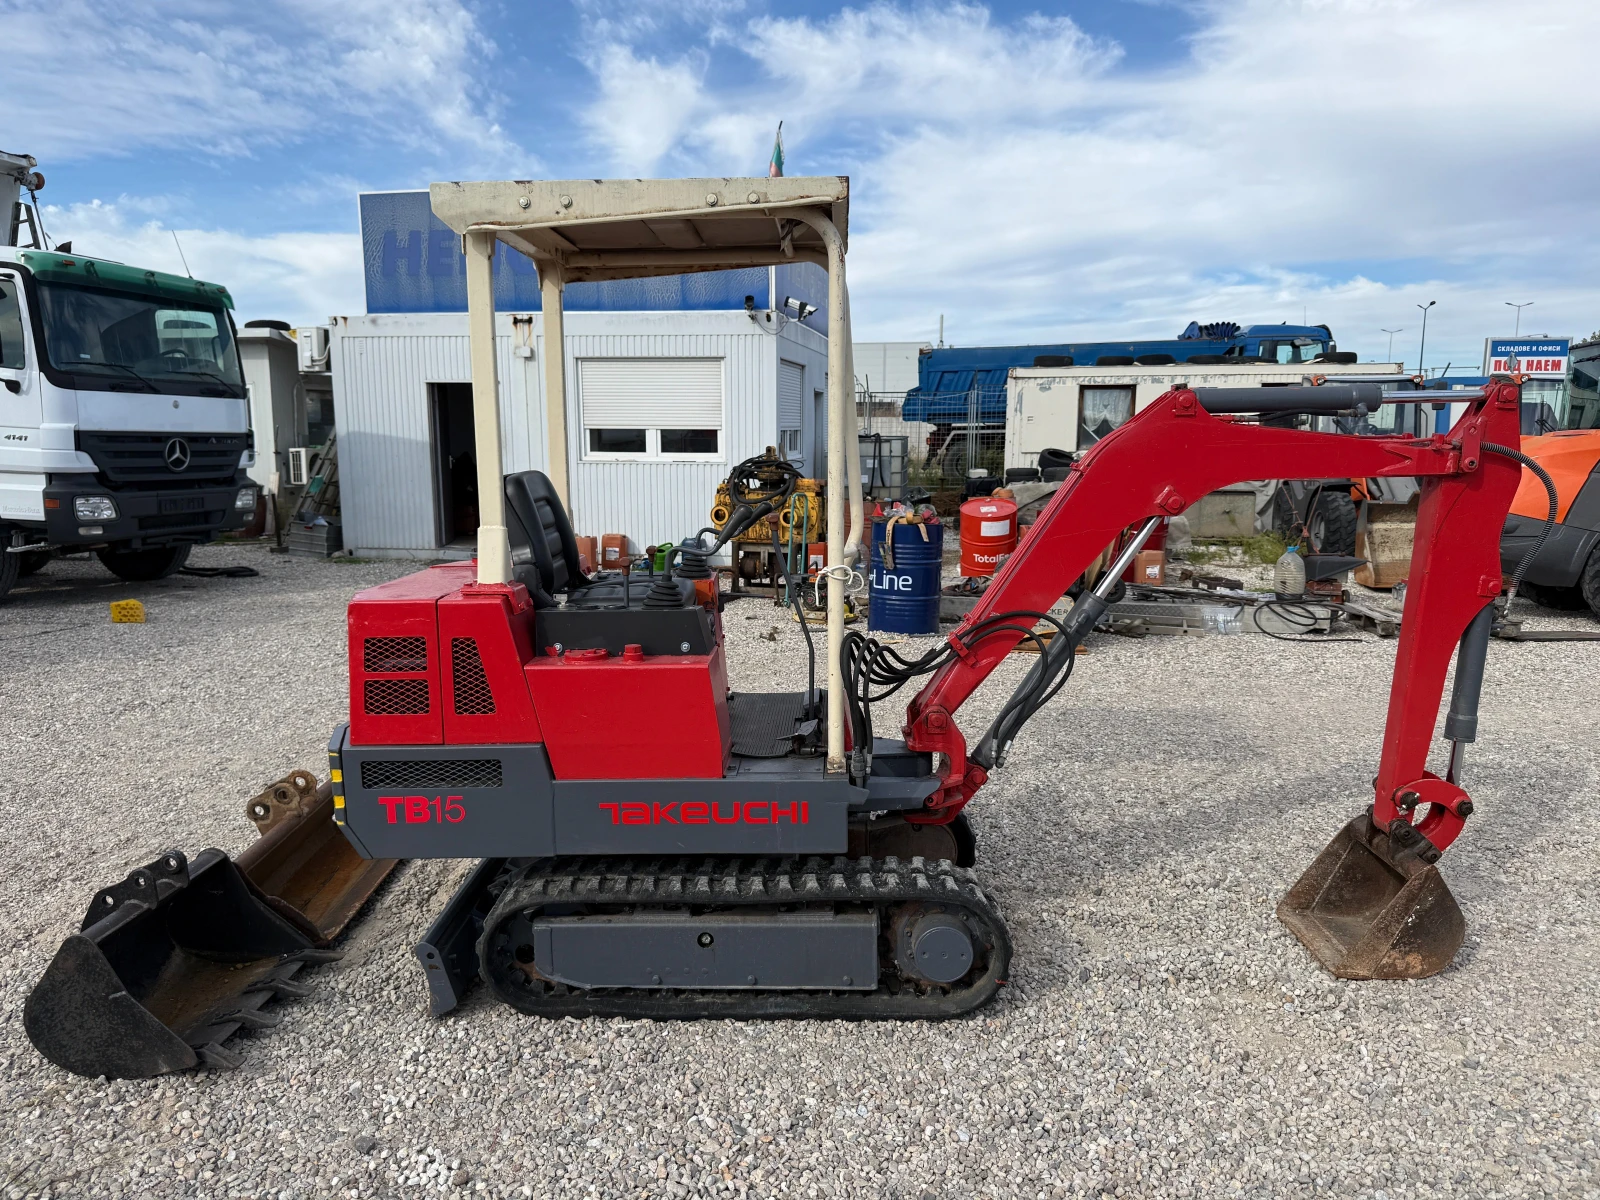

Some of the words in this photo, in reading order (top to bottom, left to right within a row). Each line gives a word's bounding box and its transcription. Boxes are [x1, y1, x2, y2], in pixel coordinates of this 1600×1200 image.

[1497, 345, 1531, 353] СКЛАДОВЕ
[1526, 359, 1562, 371] НАЕМ
[3, 434, 29, 442] 4141
[377, 795, 466, 824] TB15
[598, 801, 809, 825] TAKEUCHI
